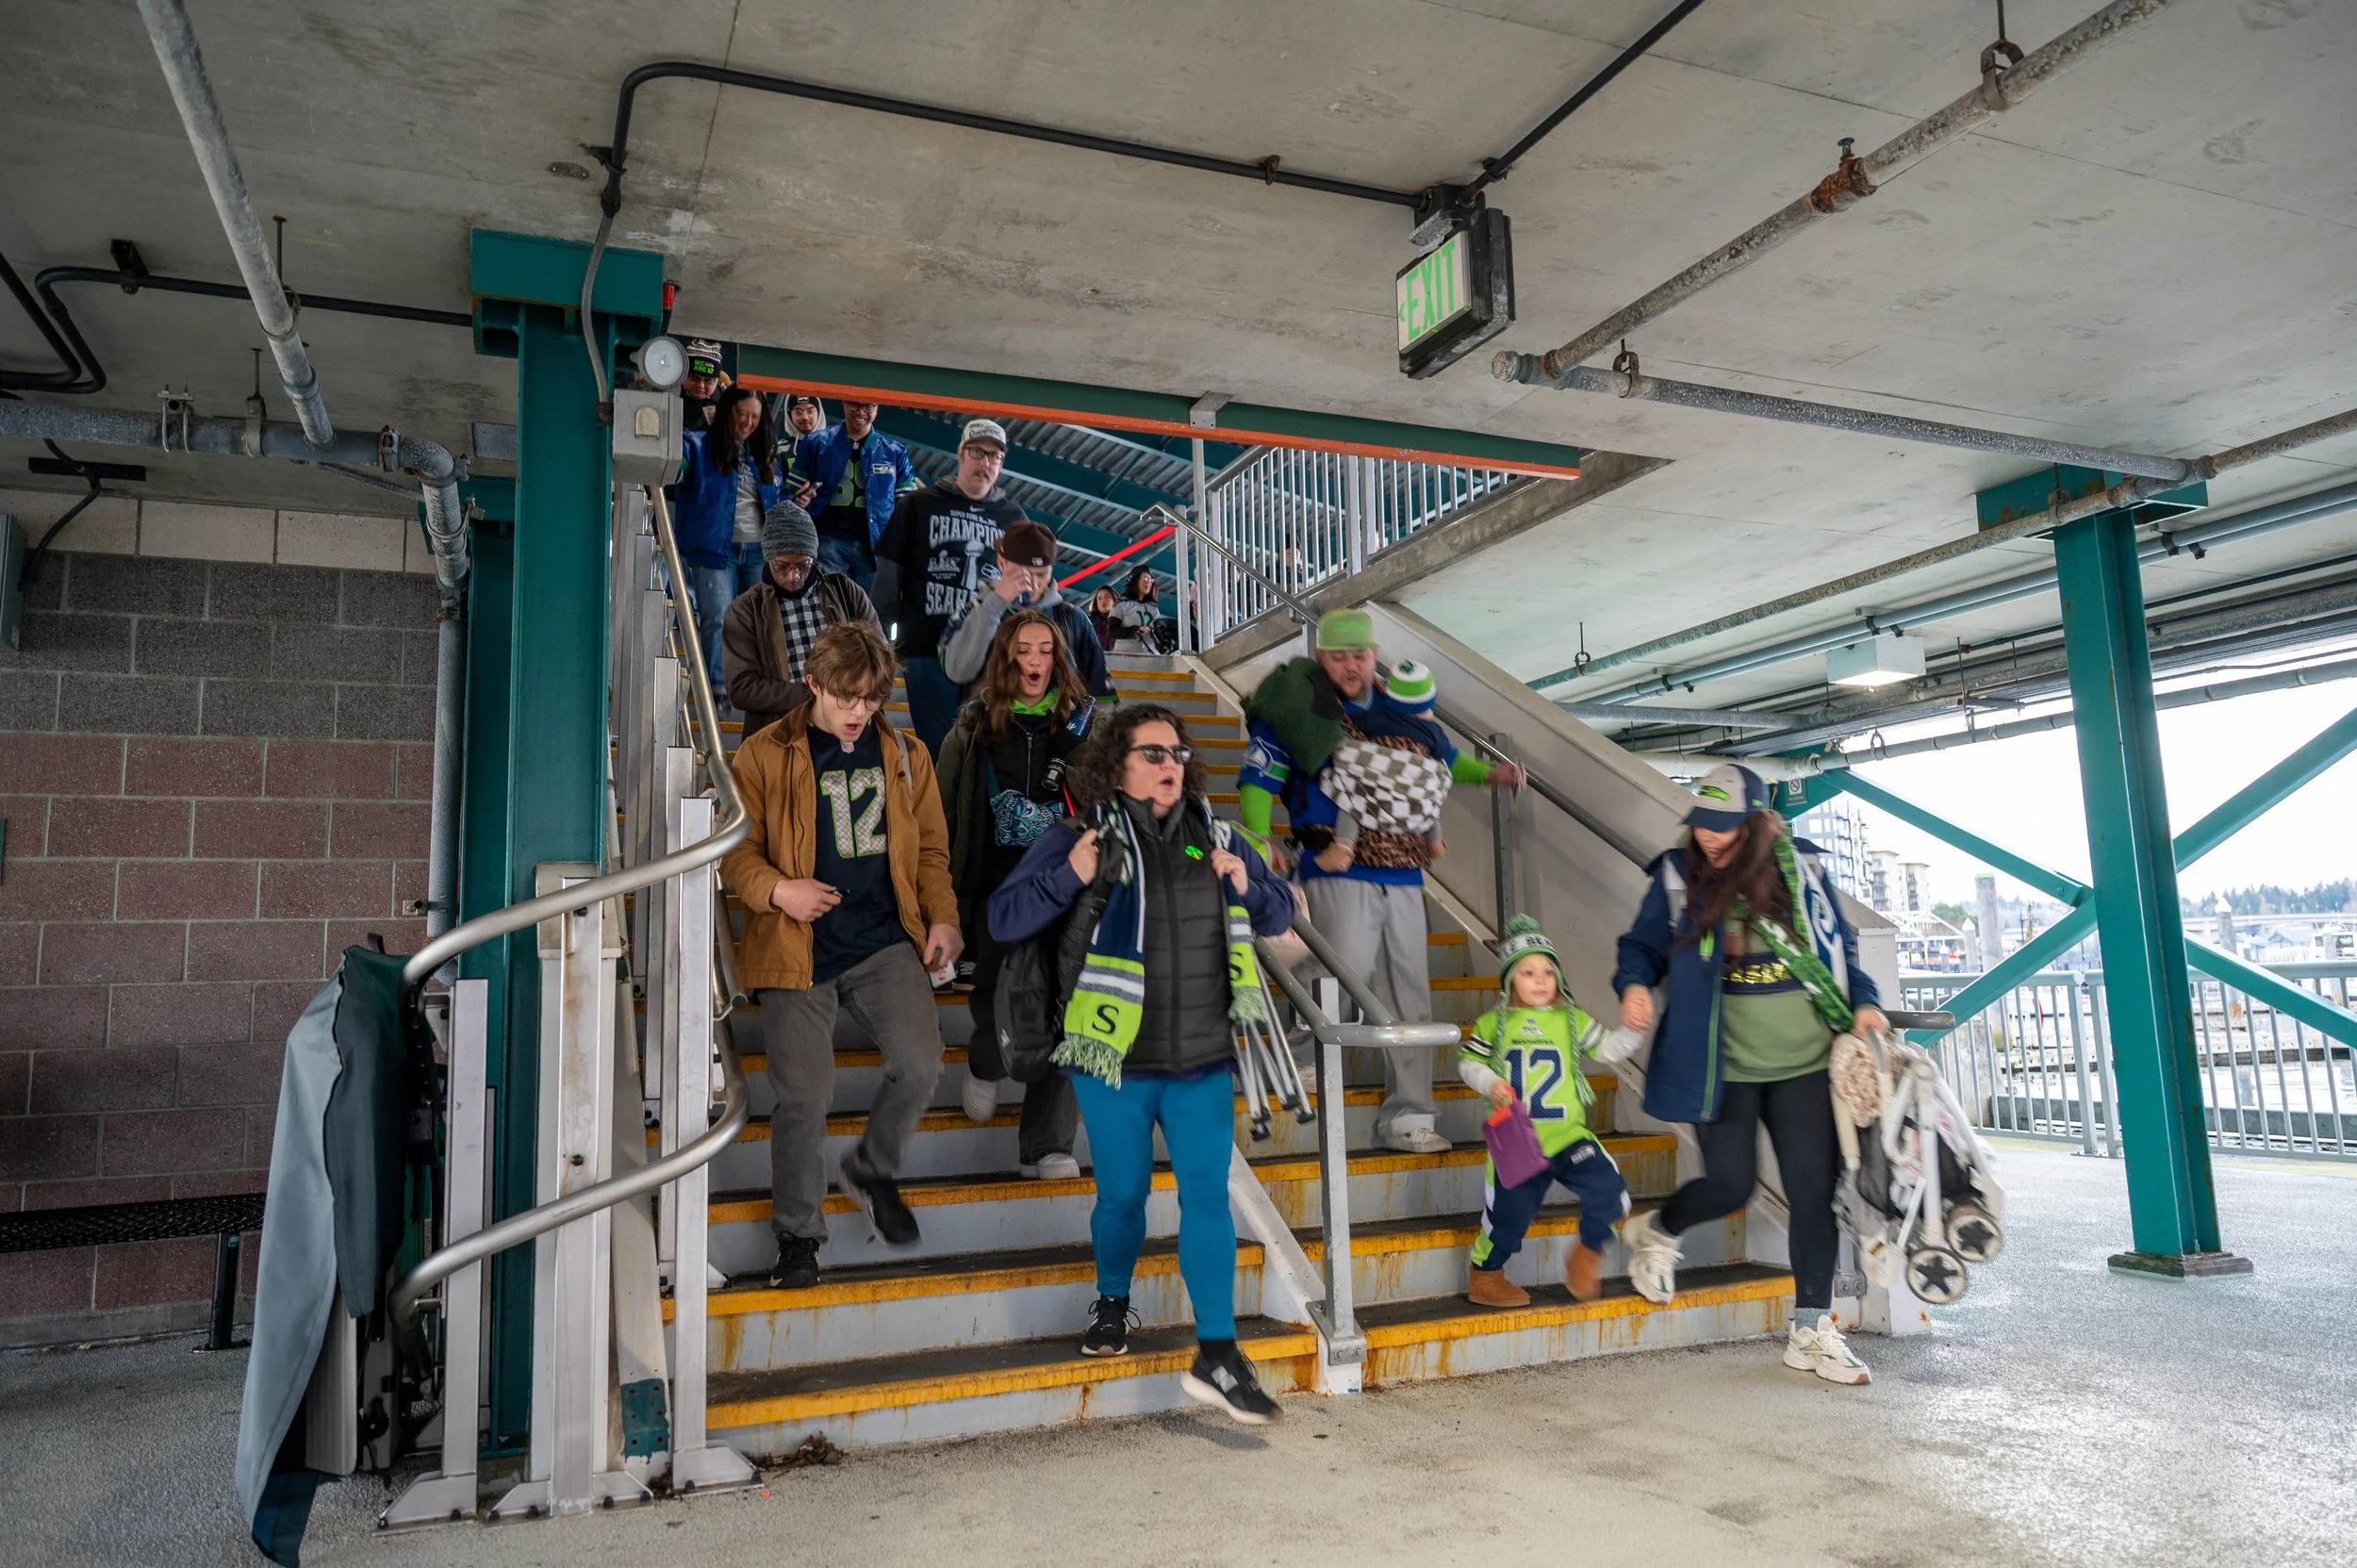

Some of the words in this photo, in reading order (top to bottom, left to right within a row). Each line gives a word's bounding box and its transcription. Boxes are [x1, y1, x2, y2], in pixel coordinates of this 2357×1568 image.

[1406, 240, 1456, 341] EXIT
[819, 767, 887, 859] 12
[1091, 1004, 1119, 1034] S
[1505, 1046, 1567, 1121] 12
